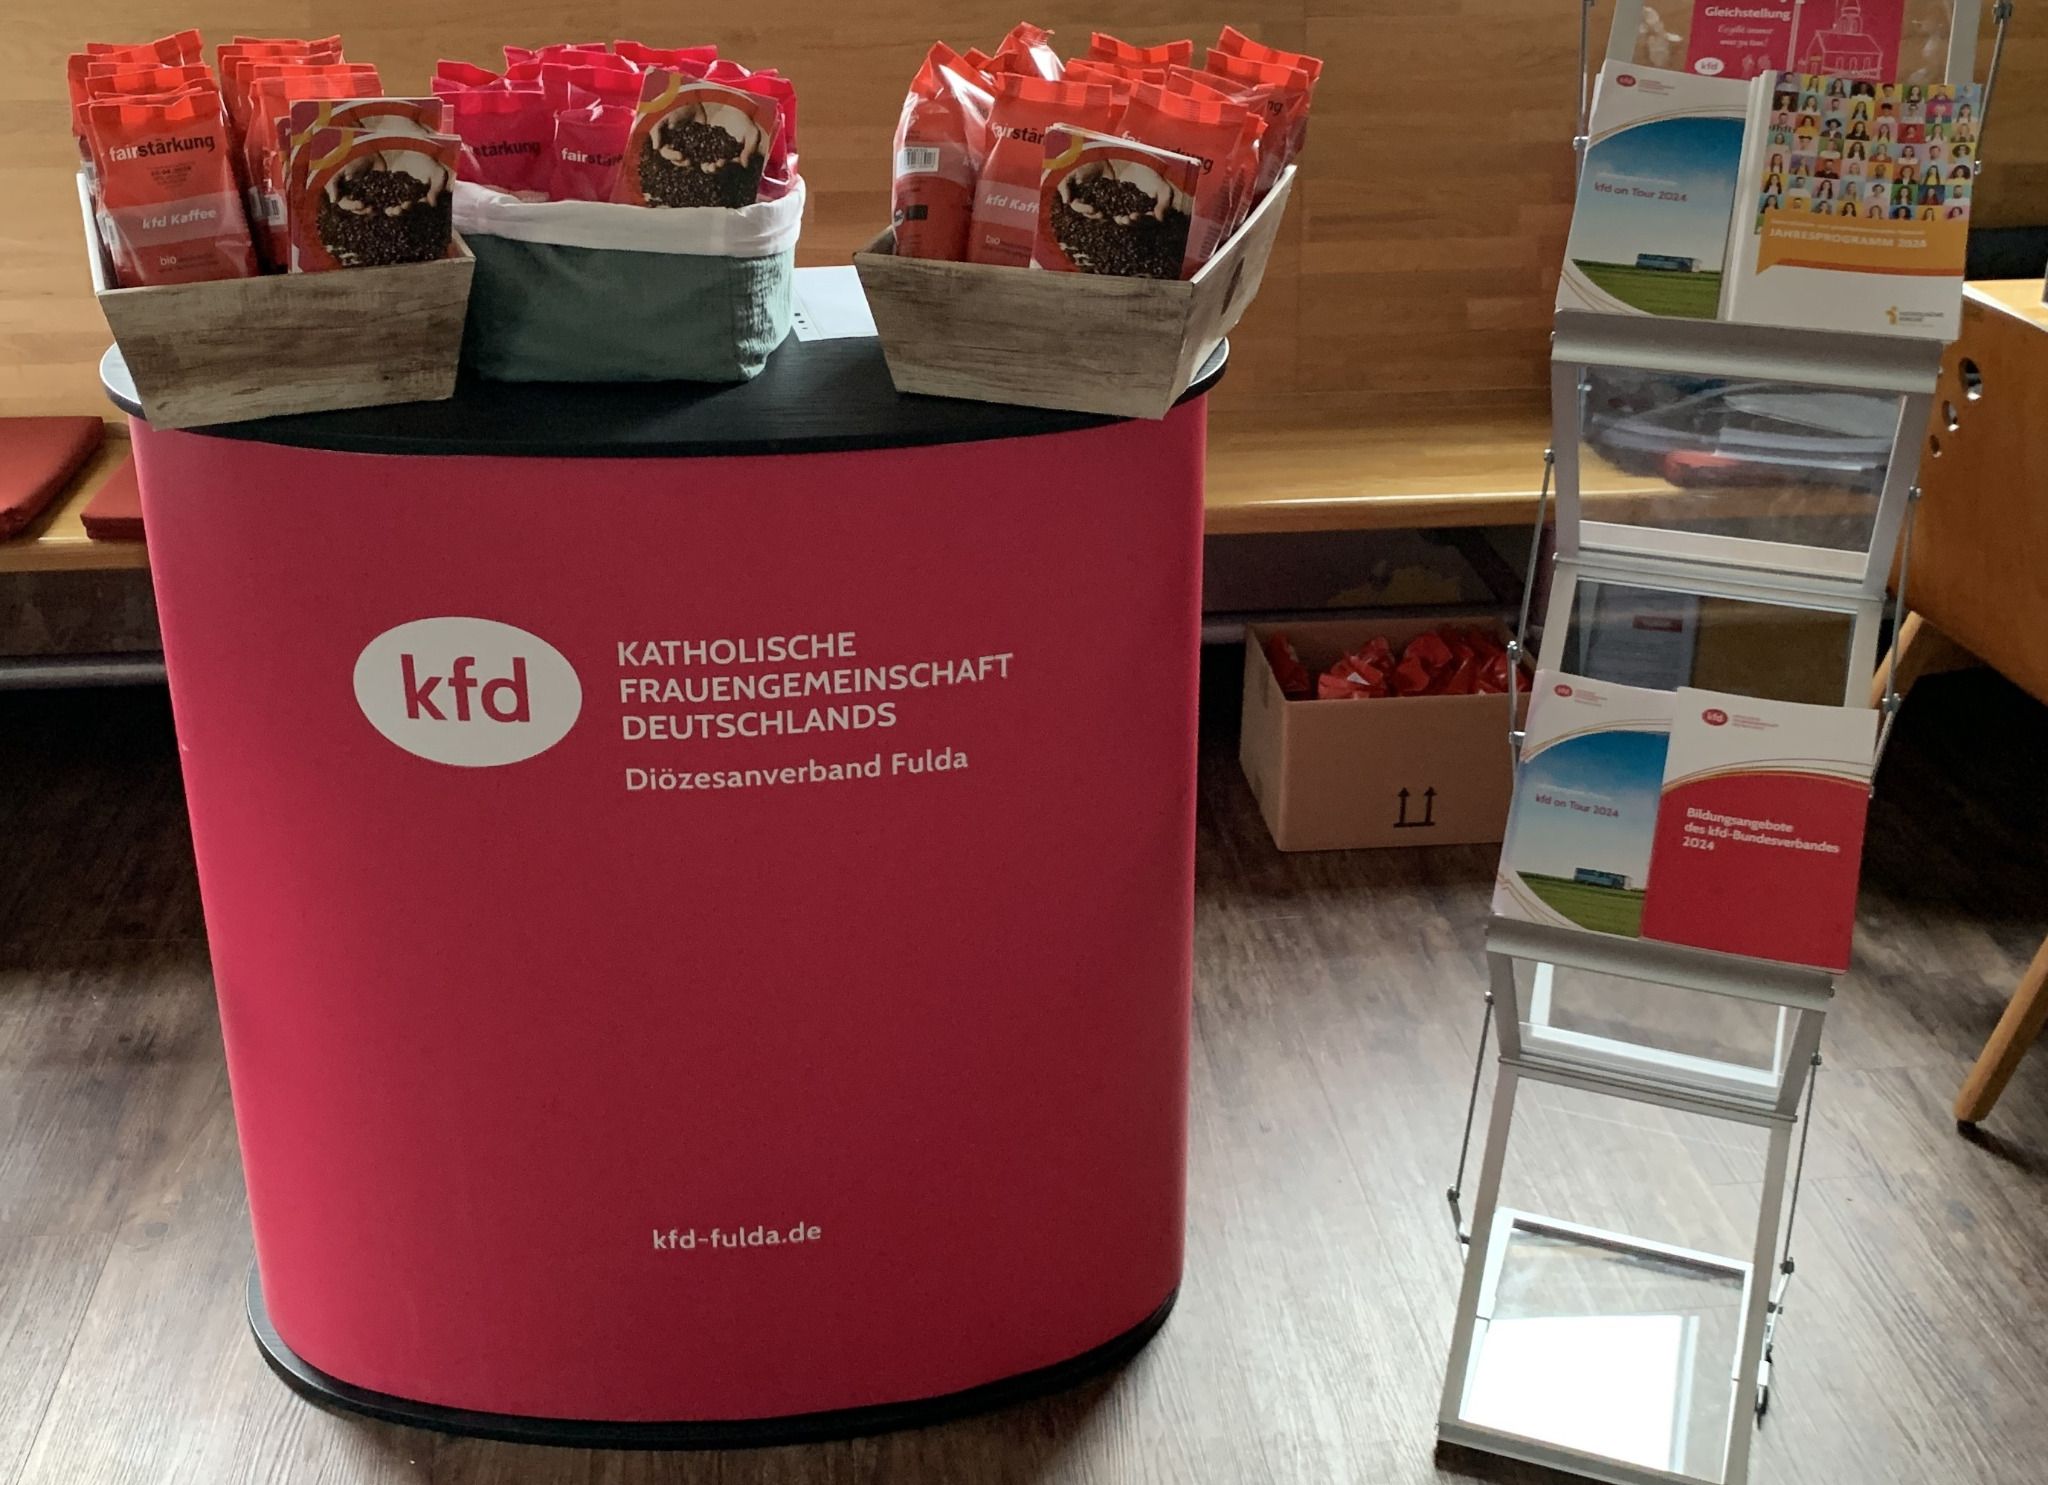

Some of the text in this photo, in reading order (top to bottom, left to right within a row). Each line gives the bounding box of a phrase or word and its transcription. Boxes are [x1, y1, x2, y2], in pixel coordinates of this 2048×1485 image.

[1705, 6, 1791, 21] Gleichstellung
[1700, 60, 1718, 71] kfd
[991, 122, 1045, 145] fairstär
[109, 136, 215, 162] fairstärkung
[466, 141, 541, 160] stärkung
[561, 147, 623, 167] fairstär
[1594, 182, 1688, 202] kfd on Tour 2024
[985, 194, 1039, 214] kfd Kaff
[142, 208, 217, 230] kfd Kaffee
[985, 234, 1000, 245] bio
[1770, 227, 1894, 248] JAHRESPROGRAMM
[160, 255, 177, 266] bio
[617, 631, 857, 668] KATHOLISCHE
[400, 653, 532, 723] kfd
[619, 652, 1014, 704] FRAUENGEMEINSCHAFT
[621, 702, 897, 741] DEUTSCHLANDS
[1707, 711, 1723, 723] kfd
[625, 747, 969, 792] Diözesanverband Fulda
[1536, 793, 1619, 817] kfd on Tour 2024
[1687, 807, 1794, 832] Bildungsangebote
[1682, 836, 1715, 851] 2024
[1684, 822, 1840, 853] des kfd-Bundesverbandes
[653, 1221, 822, 1250] kfd-fulda.de
